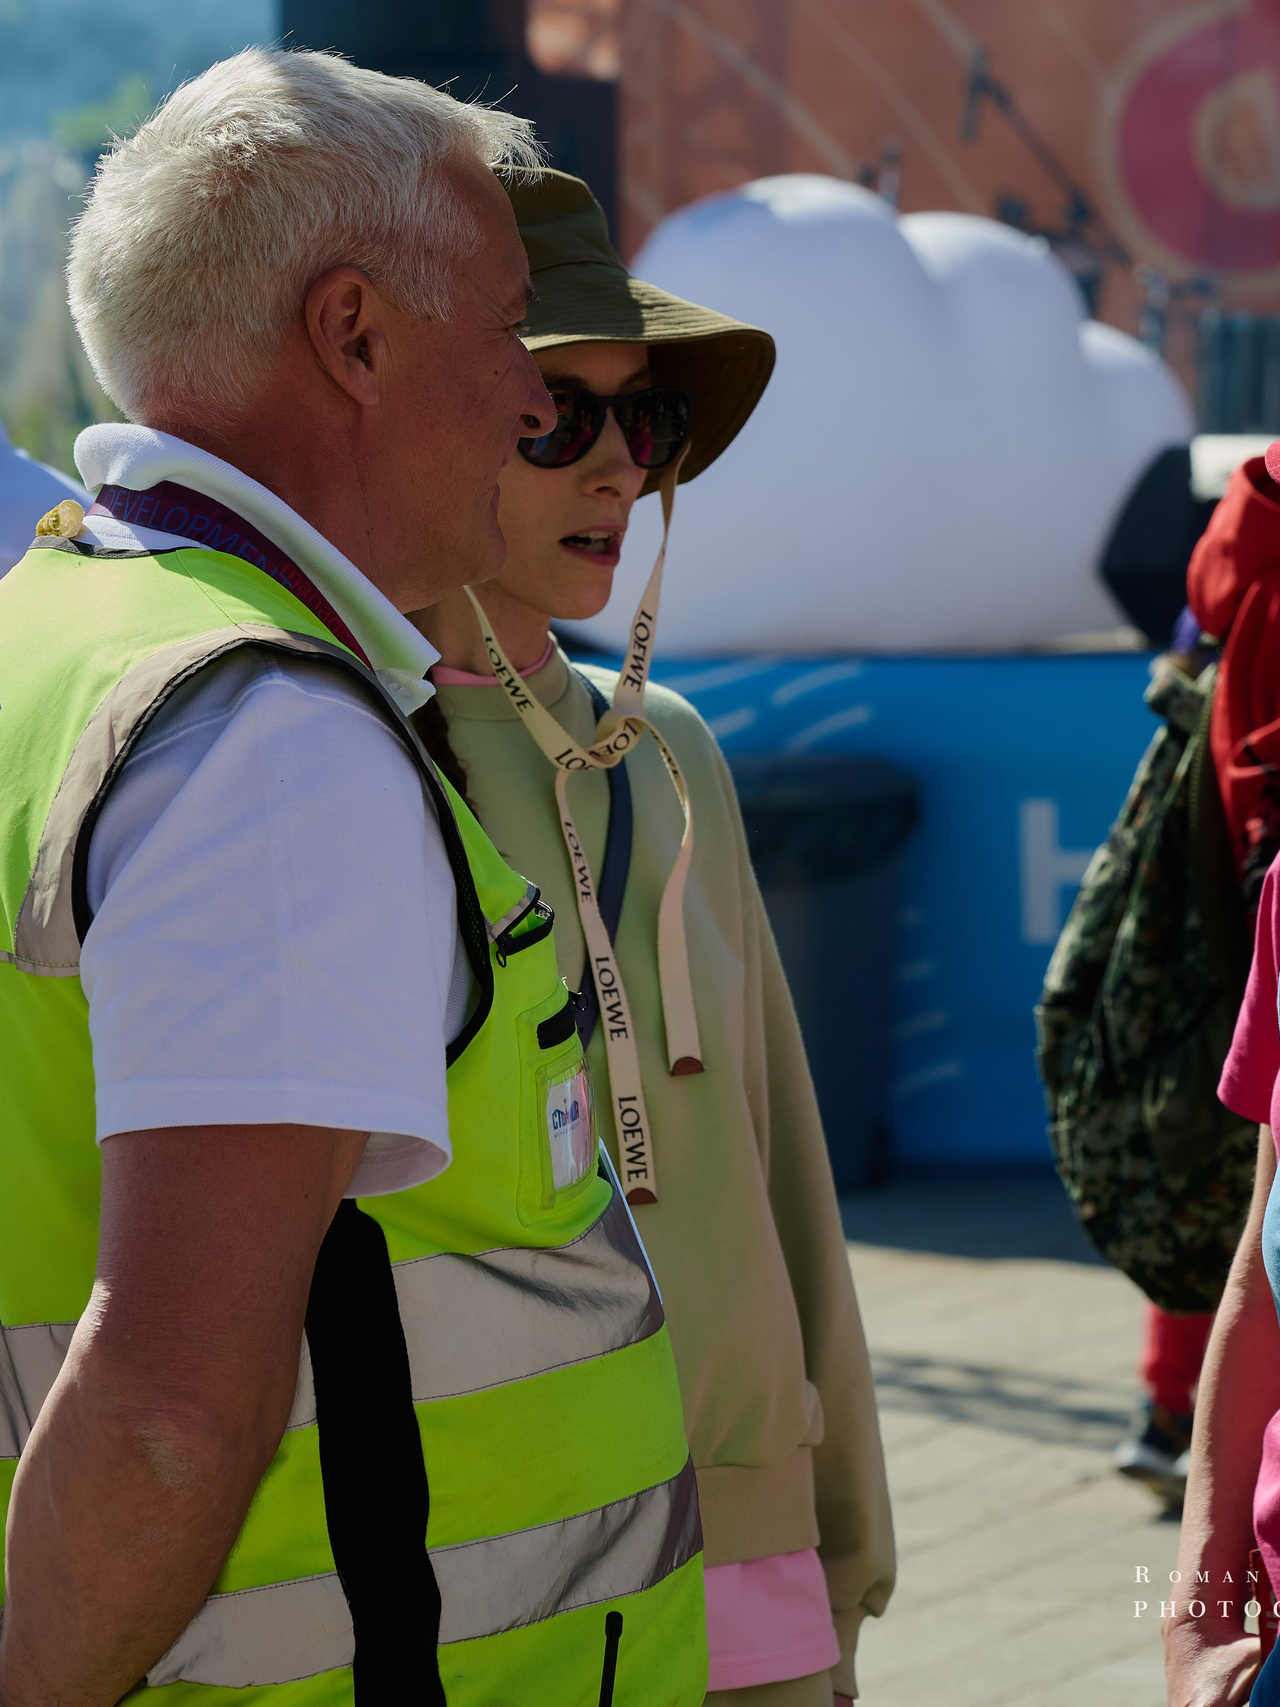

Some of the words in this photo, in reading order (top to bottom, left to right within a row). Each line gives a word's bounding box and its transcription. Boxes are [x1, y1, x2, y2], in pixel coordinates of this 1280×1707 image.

[484, 636, 534, 713] LOEWE
[622, 609, 653, 693] LOEWE
[564, 821, 593, 904] LOEWE
[595, 956, 628, 1042] LOEWE
[618, 1096, 648, 1182] LOEWE
